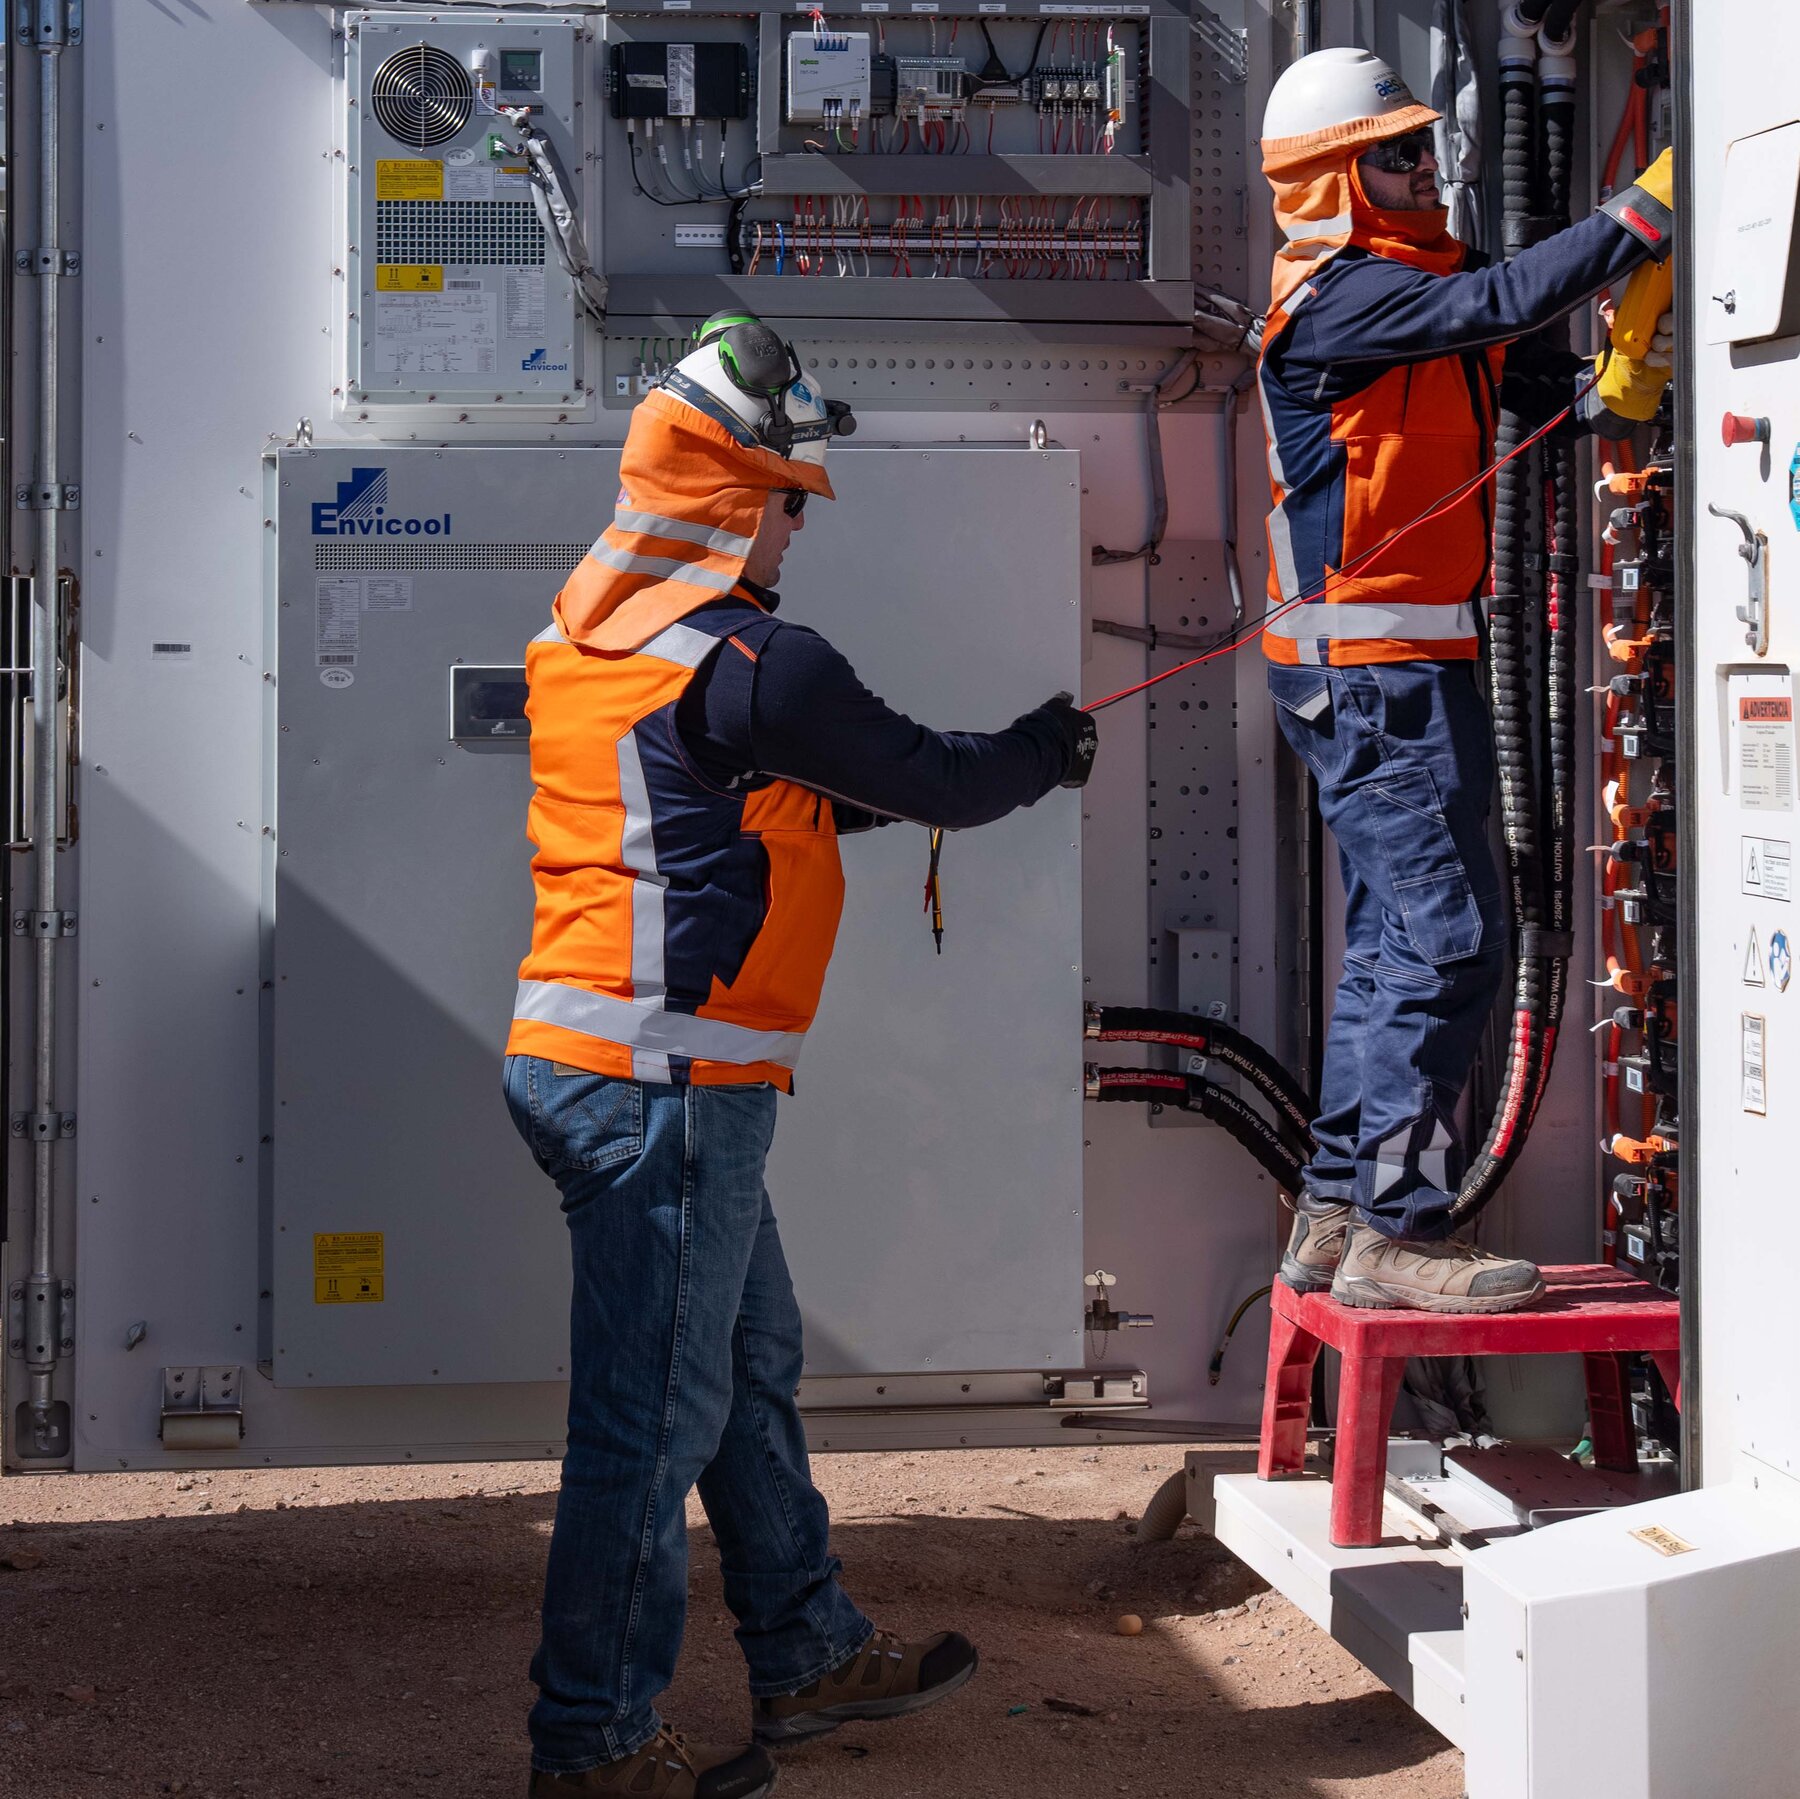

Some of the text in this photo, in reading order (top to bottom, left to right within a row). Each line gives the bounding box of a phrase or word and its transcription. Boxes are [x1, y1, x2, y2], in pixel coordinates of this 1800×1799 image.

[1375, 79, 1400, 96] aes
[521, 360, 568, 371] Envicool
[790, 430, 820, 440] ENIX
[311, 502, 451, 535] Envicool
[1750, 700, 1789, 718] ADVERTENCIA
[1512, 876, 1523, 906] 250PSI
[1553, 890, 1563, 920] 250PSI
[1518, 977, 1528, 1003] HARD
[1550, 968, 1560, 993] WALL
[1547, 994, 1558, 1019] HARD
[1234, 1054, 1254, 1071] WALL
[1252, 1067, 1274, 1088] TYPE
[1284, 1102, 1309, 1128] 250PSI
[1220, 1094, 1241, 1112] WALL
[1240, 1108, 1262, 1128] TYPE
[1275, 1142, 1300, 1168] 250PSI
